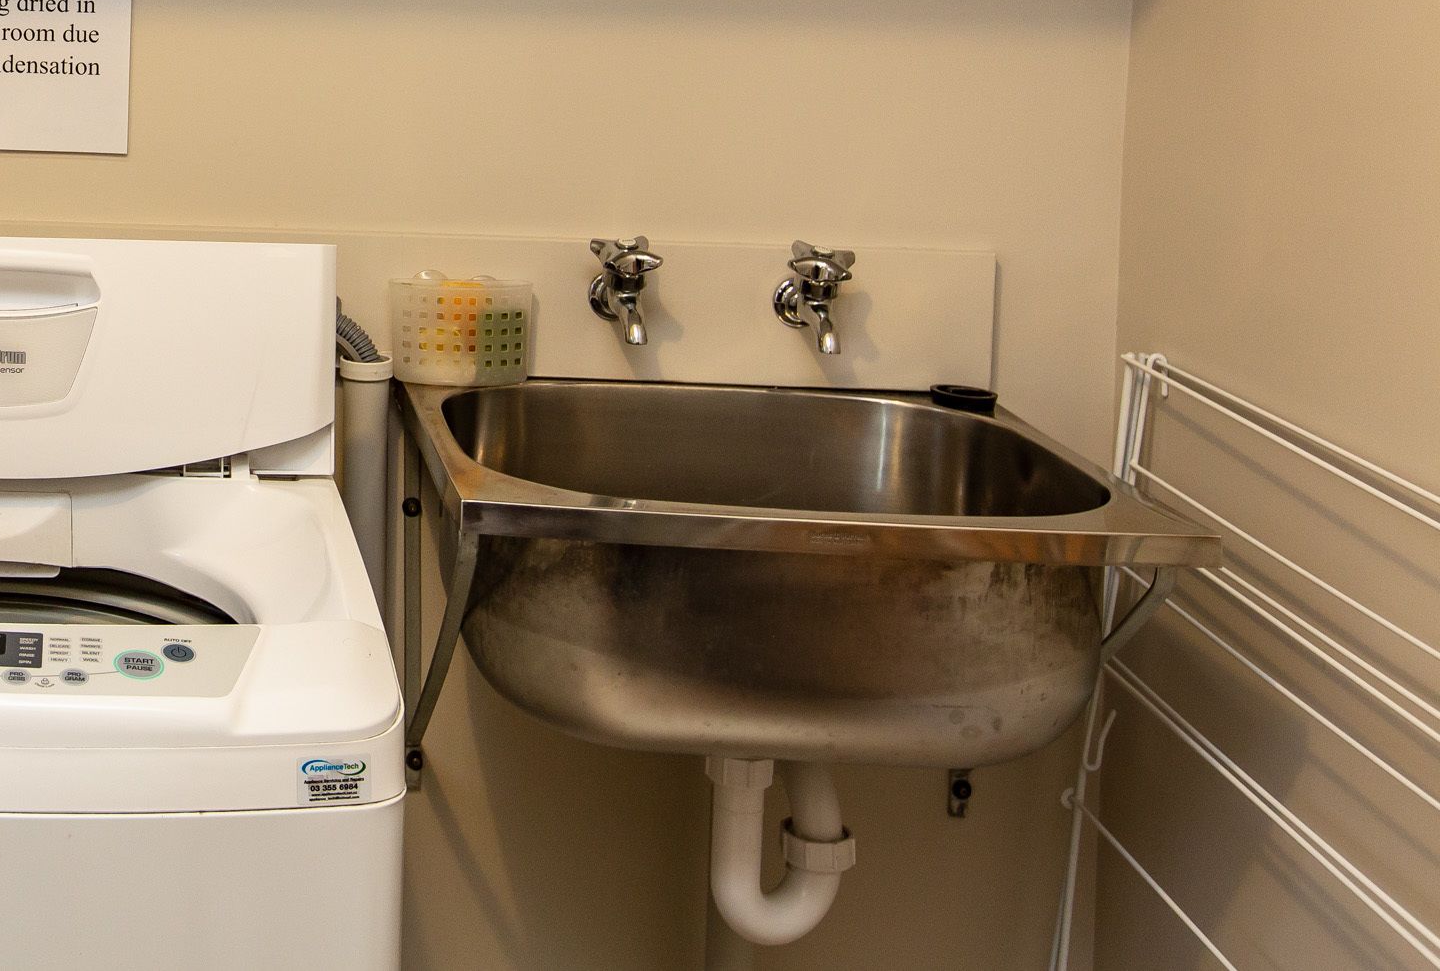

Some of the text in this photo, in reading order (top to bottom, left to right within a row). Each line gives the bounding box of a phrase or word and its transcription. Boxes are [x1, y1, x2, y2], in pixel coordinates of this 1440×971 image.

[2, 27, 55, 42] room
[63, 24, 99, 43] due
[310, 763, 359, 772] ApplianceTech
